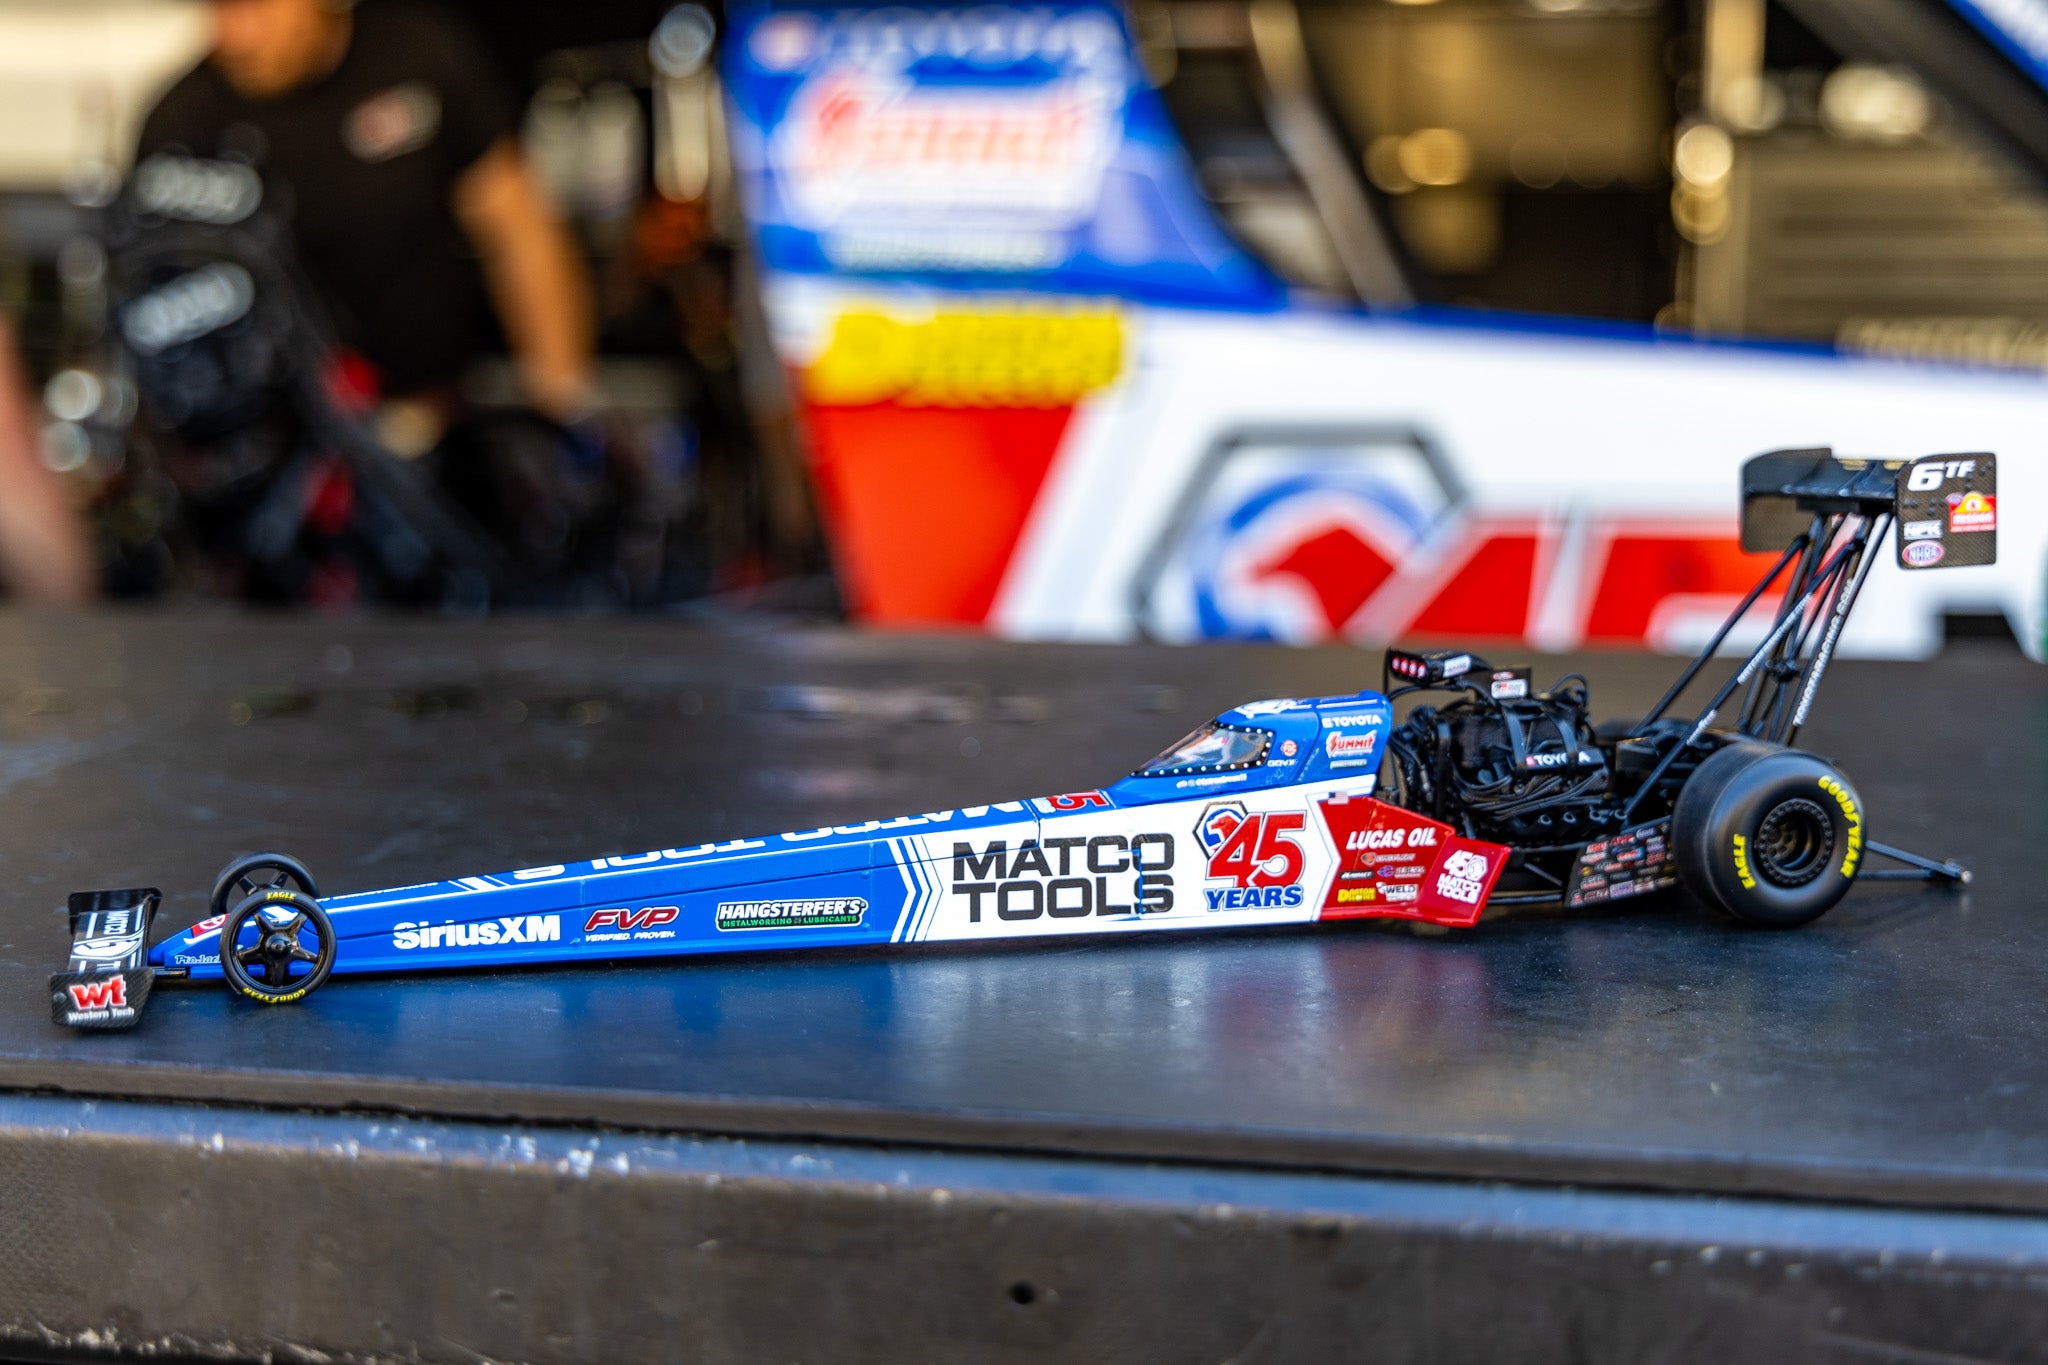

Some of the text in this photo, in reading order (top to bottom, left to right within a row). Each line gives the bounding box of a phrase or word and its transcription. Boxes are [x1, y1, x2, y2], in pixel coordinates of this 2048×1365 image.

[1334, 713, 1383, 728] TOYOTA
[1346, 827, 1438, 850] LUCAS OIL
[1818, 775, 1862, 879] GOODYEAR
[953, 832, 1175, 882] MATCO
[1205, 810, 1308, 890] 45
[1733, 833, 1757, 889] EAGLE
[266, 891, 297, 901] EAGLE
[719, 900, 861, 919] HANGSTERFER'S
[952, 873, 1175, 923] TOOLS
[1203, 883, 1305, 911] YEARS
[393, 915, 560, 950] SiriusXM
[584, 906, 680, 932] FVP
[722, 914, 857, 927] METALWORKING LUBRICANTS
[67, 1007, 135, 1022] Western Tech
